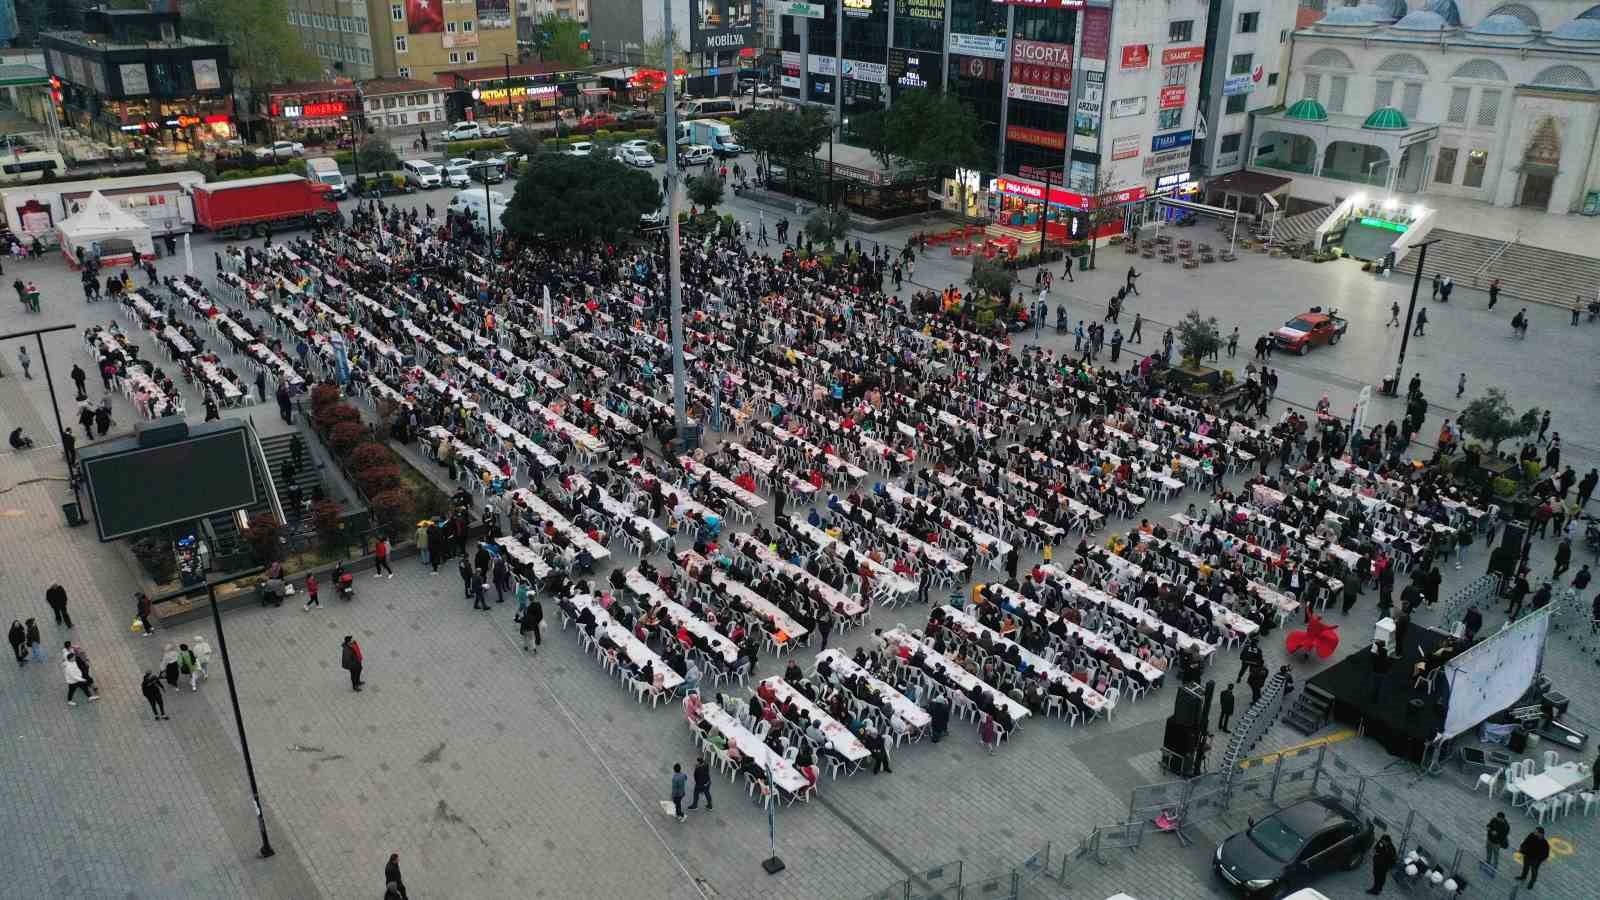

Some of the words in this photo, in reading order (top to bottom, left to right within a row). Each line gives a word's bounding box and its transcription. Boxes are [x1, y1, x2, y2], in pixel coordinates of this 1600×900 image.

[707, 33, 744, 47] MOBİLYA
[1015, 44, 1069, 62] SİGORTA
[1078, 101, 1100, 111] ARZUM
[1006, 182, 1021, 192] PAŞA
[1021, 184, 1041, 197] DÖNER
